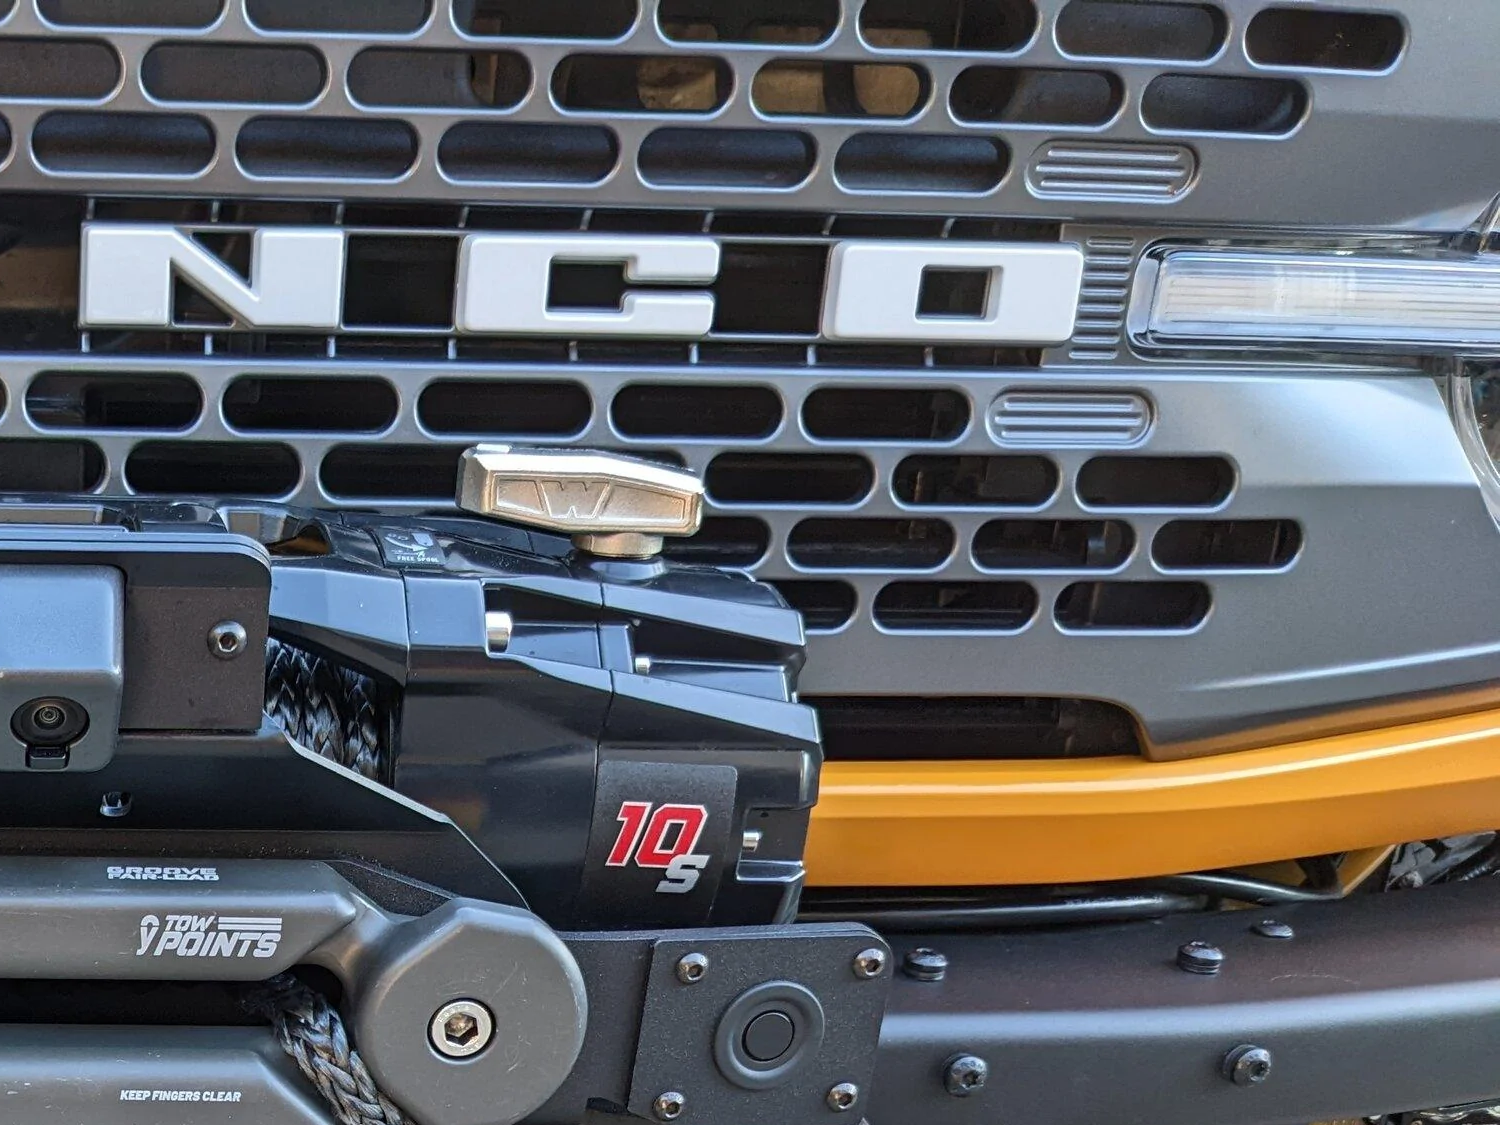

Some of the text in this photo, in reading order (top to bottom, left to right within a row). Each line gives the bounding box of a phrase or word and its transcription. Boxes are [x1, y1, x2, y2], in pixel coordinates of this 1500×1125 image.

[165, 914, 214, 932] TOW
[153, 931, 282, 958] POINTS
[120, 1090, 242, 1102] KEEP FINGERS CLEAR
